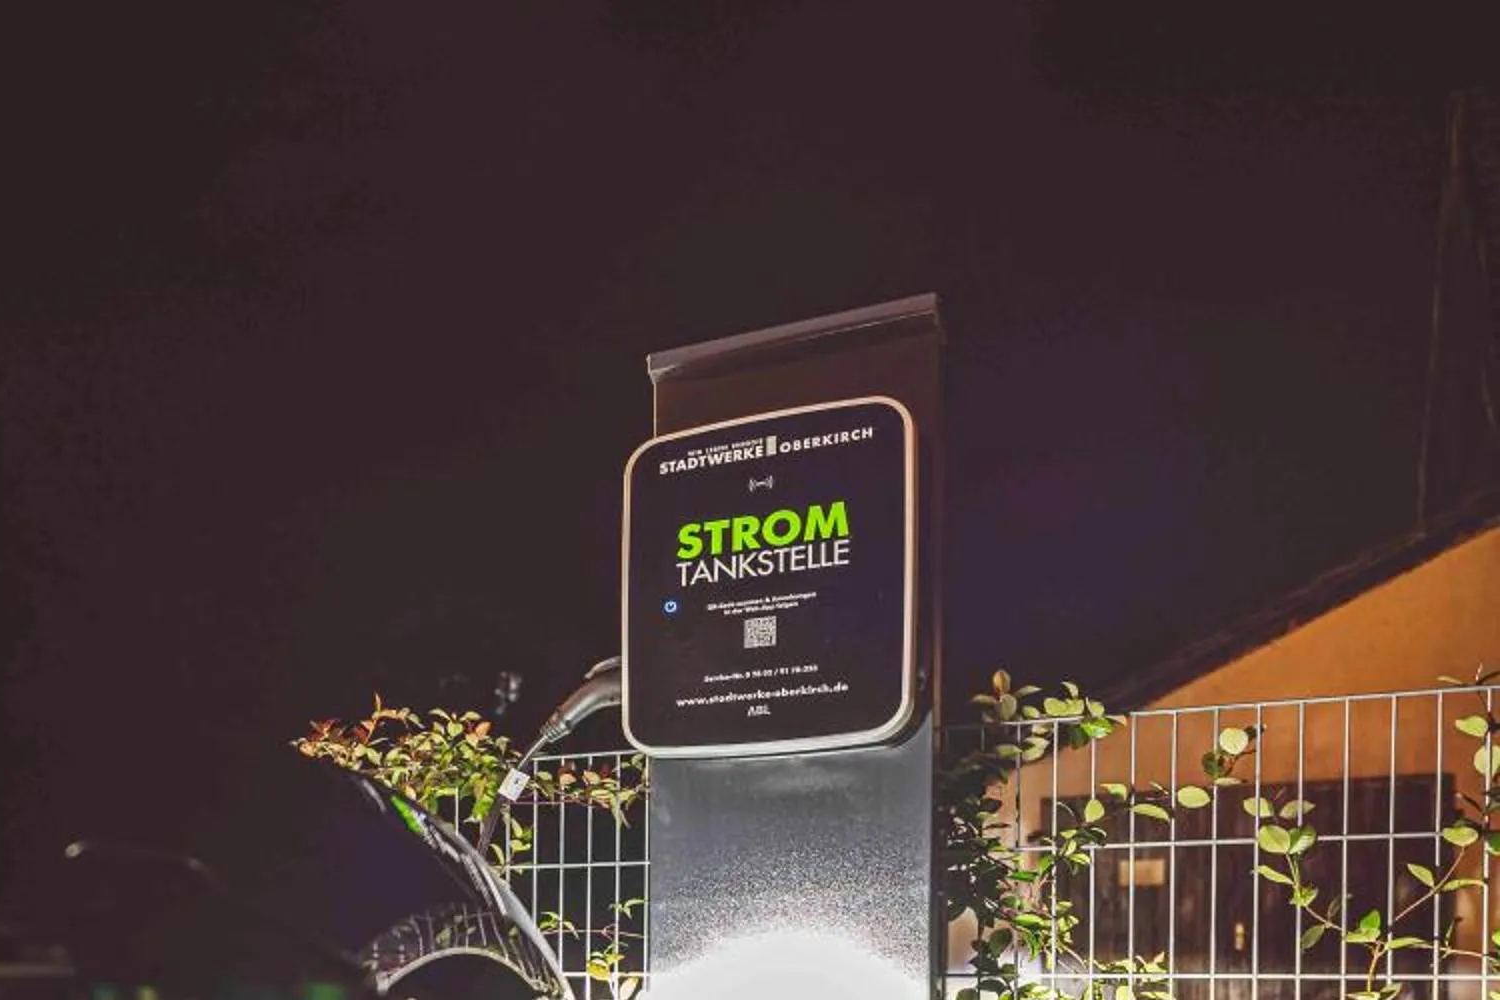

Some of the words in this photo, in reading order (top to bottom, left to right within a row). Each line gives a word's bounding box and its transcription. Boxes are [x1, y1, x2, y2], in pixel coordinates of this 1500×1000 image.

[659, 445, 764, 475] STADTWERKE
[779, 427, 873, 454] OBERKIRCH
[676, 501, 849, 560] STROM
[676, 539, 850, 587] TANKSTELLE
[676, 681, 849, 706] www.stadtwerke-oberkirch.de
